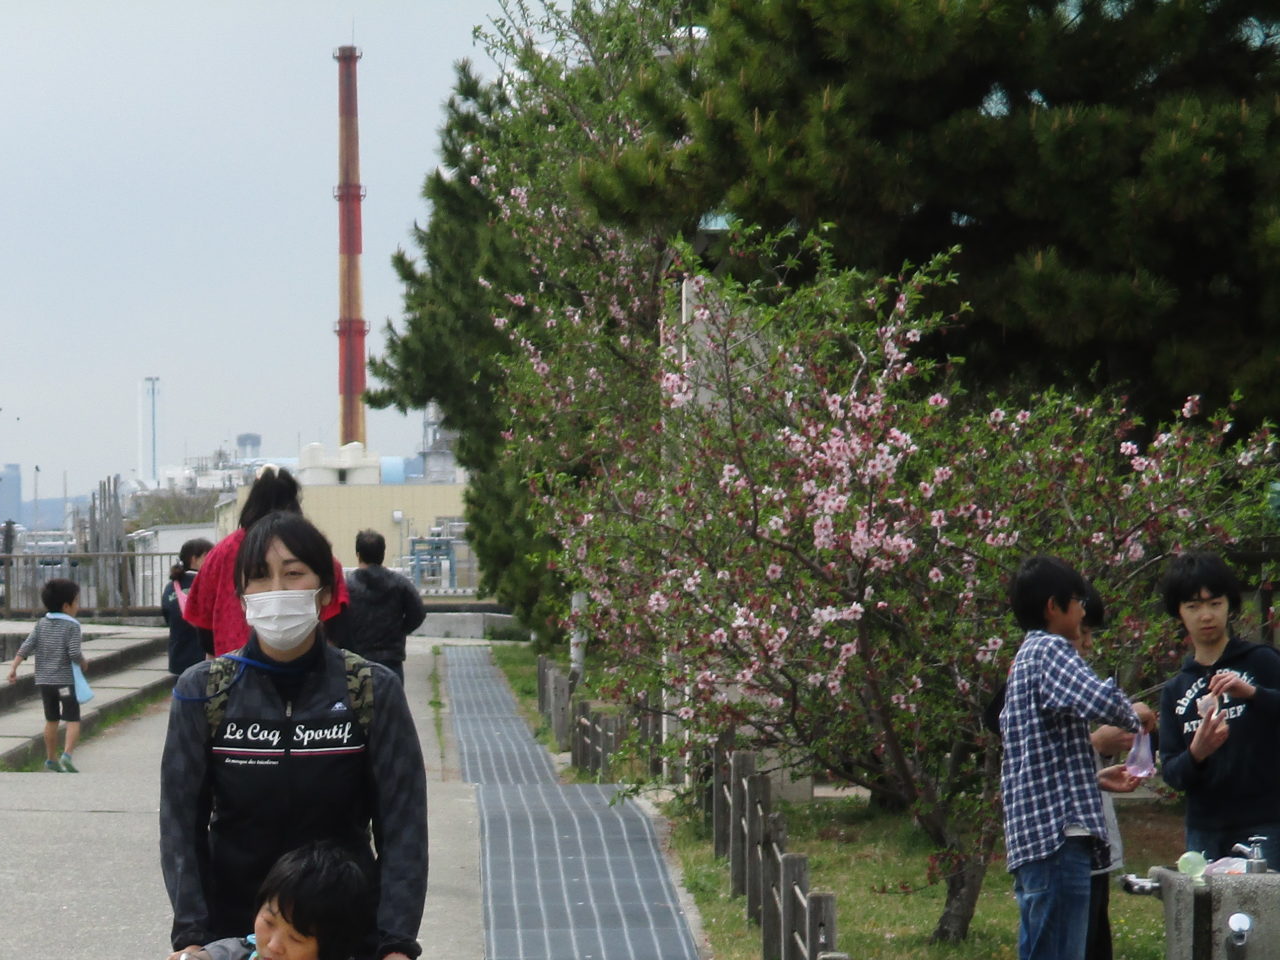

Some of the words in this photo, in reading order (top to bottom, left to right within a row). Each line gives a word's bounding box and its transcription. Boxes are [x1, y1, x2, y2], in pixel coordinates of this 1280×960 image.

[223, 722, 244, 740] Le
[247, 723, 281, 747] Coq
[293, 721, 353, 747] Sportif
